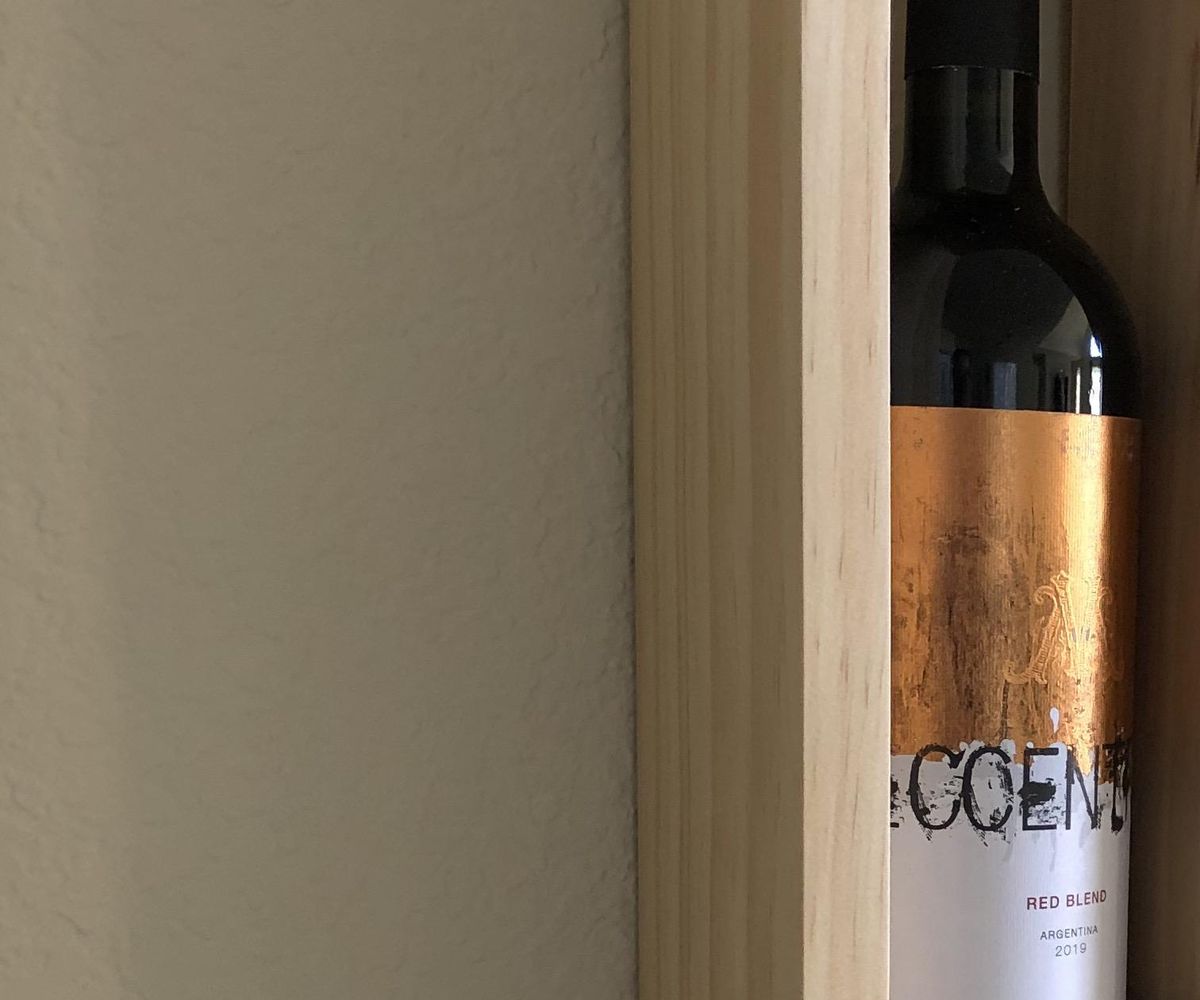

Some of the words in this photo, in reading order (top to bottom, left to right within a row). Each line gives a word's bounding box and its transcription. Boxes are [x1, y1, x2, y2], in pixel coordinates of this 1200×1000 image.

[1026, 895, 1060, 911] RED
[1065, 889, 1107, 908] BLEND
[1039, 925, 1099, 941] ARGENTINA
[1055, 942, 1087, 957] 2019
